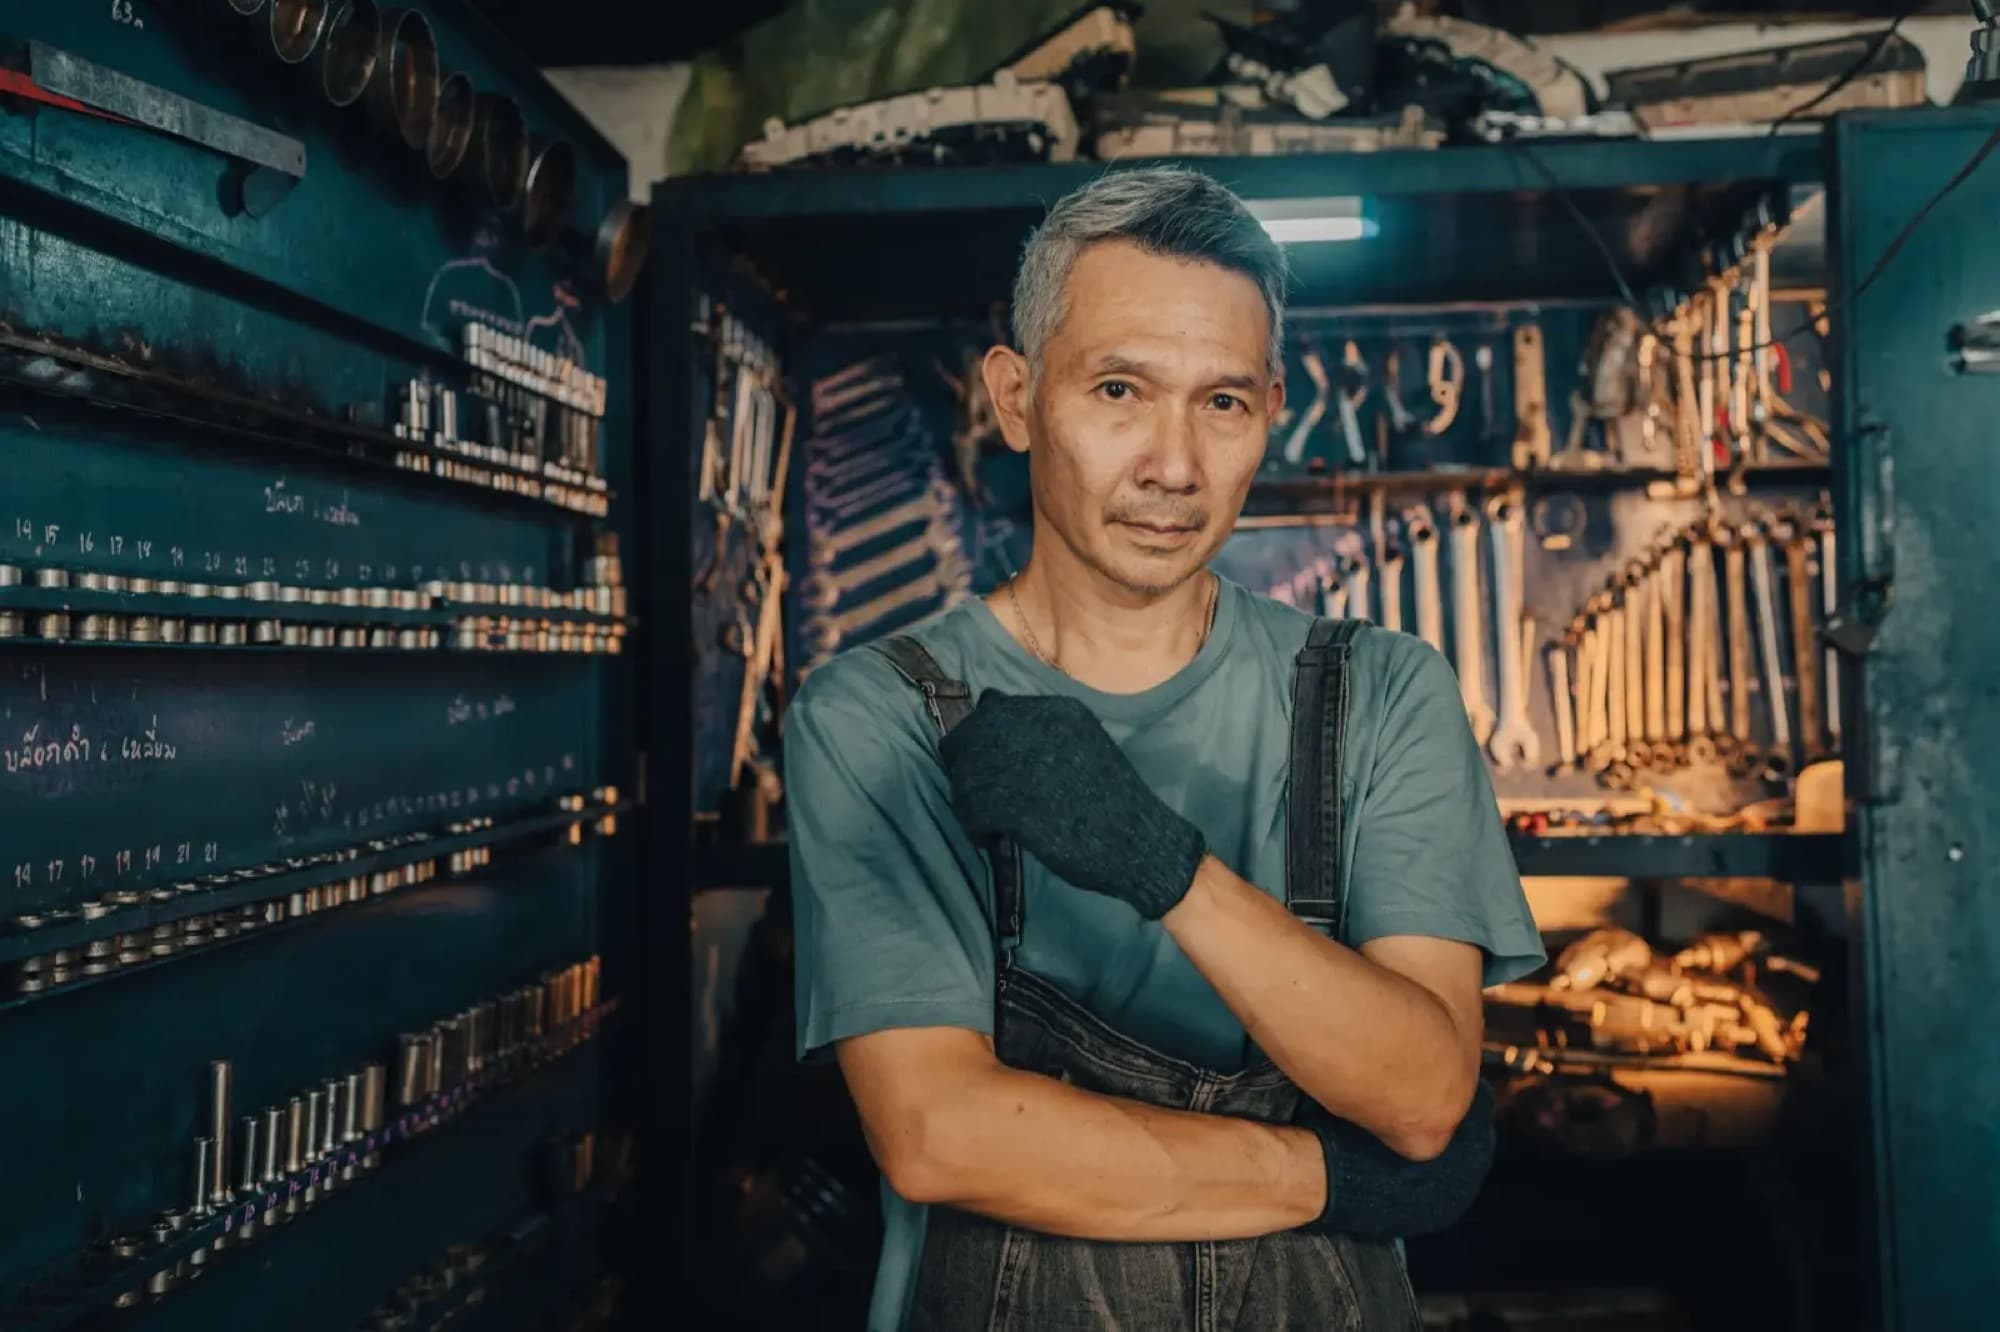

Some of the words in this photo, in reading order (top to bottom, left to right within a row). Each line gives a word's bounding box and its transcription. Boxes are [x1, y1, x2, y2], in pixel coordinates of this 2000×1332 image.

[44, 524, 60, 545] 15
[79, 531, 95, 554] 16
[109, 535, 124, 556] 17
[137, 540, 152, 560] 18
[169, 546, 184, 567] 19
[204, 551, 221, 572] 20
[48, 859, 64, 883] 17
[80, 853, 96, 880] 17
[115, 849, 131, 876] 19
[176, 841, 190, 864] 21
[204, 841, 218, 863] 21
